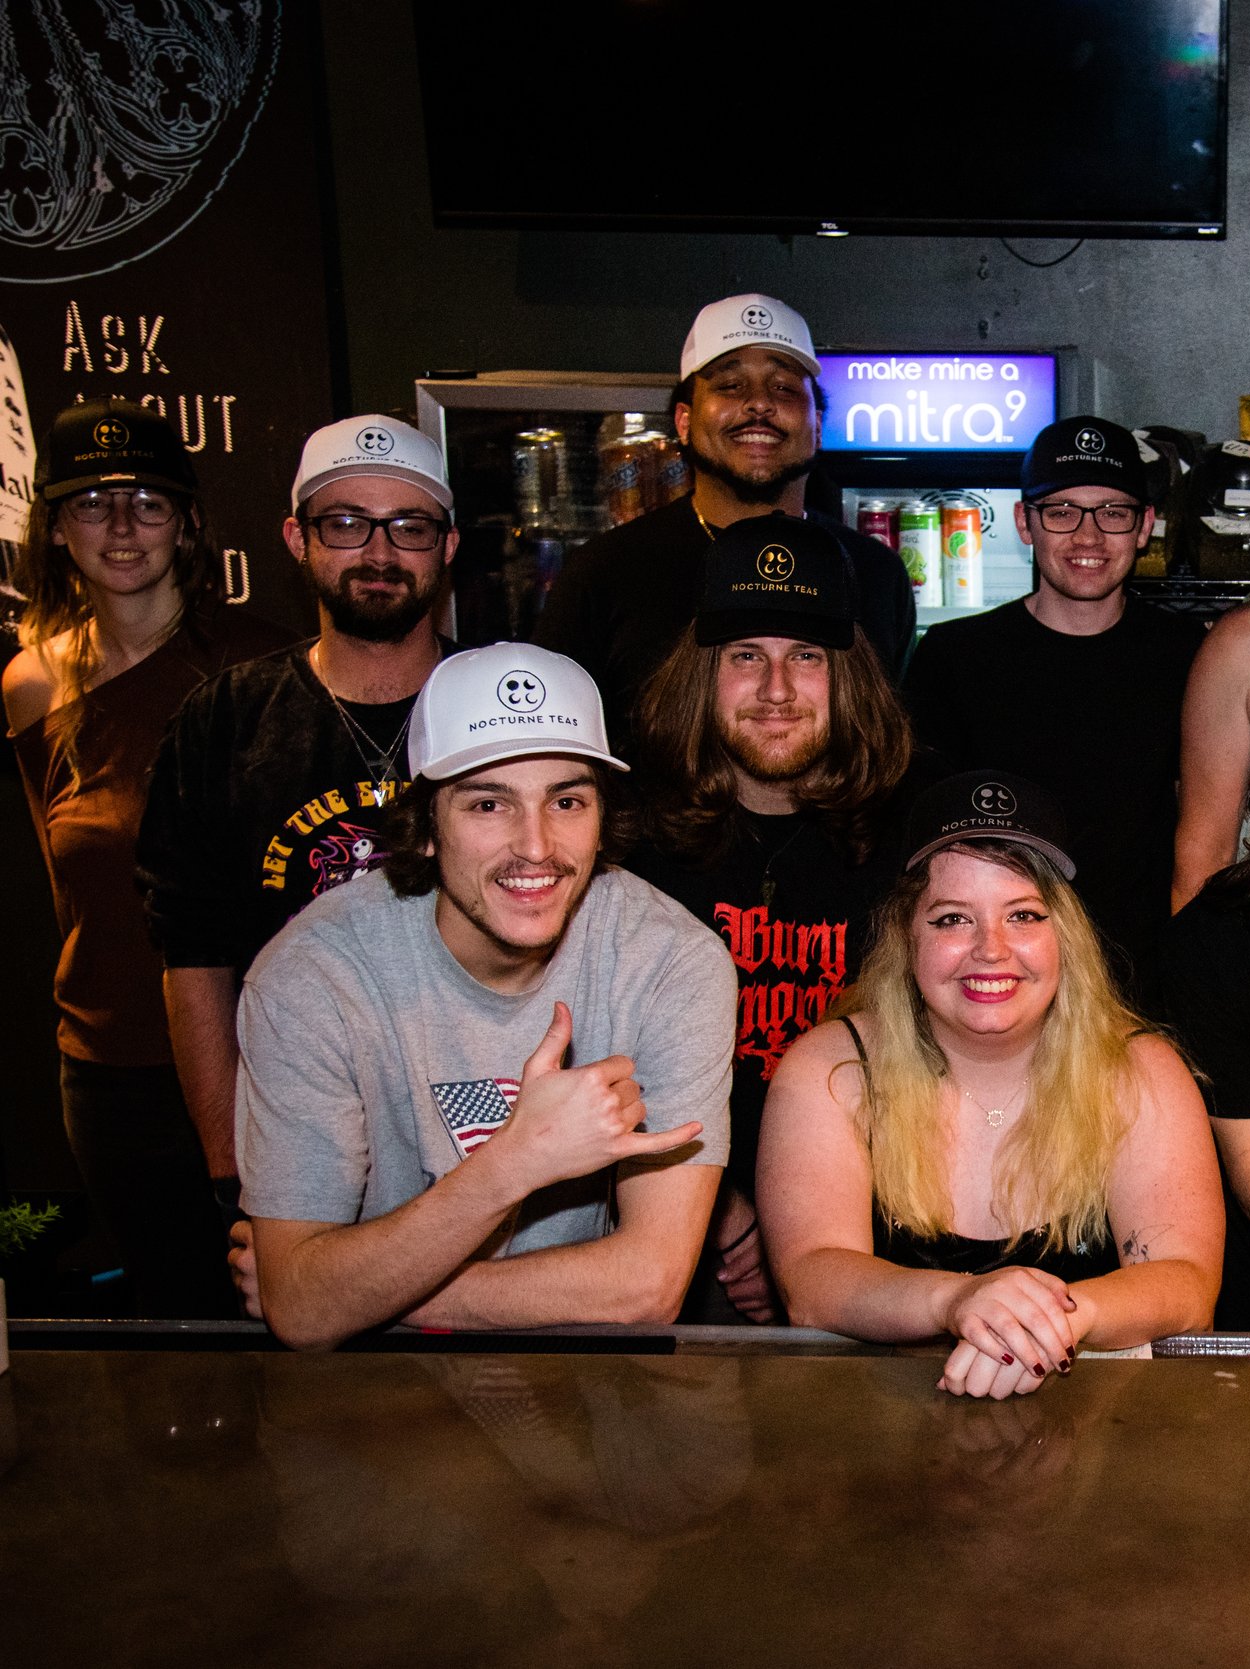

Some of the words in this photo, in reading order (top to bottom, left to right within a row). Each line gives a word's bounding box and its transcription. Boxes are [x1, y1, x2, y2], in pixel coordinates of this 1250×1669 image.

[722, 330, 771, 341] NOCTURNE
[773, 333, 793, 344] TEAS
[847, 357, 922, 382] make
[929, 357, 994, 381] mine
[1001, 363, 1019, 381] a
[1056, 453, 1102, 463] NOCTURNE
[1104, 456, 1123, 469] TEAS
[731, 582, 791, 593] NOCTURNE
[793, 584, 818, 596] TEAS
[469, 715, 544, 732] NOCTURNE
[548, 715, 578, 727] TEAS
[941, 818, 1013, 833] NOCTURNE
[262, 835, 294, 892] LET
[284, 788, 350, 836] THE
[713, 902, 848, 987] Bury
